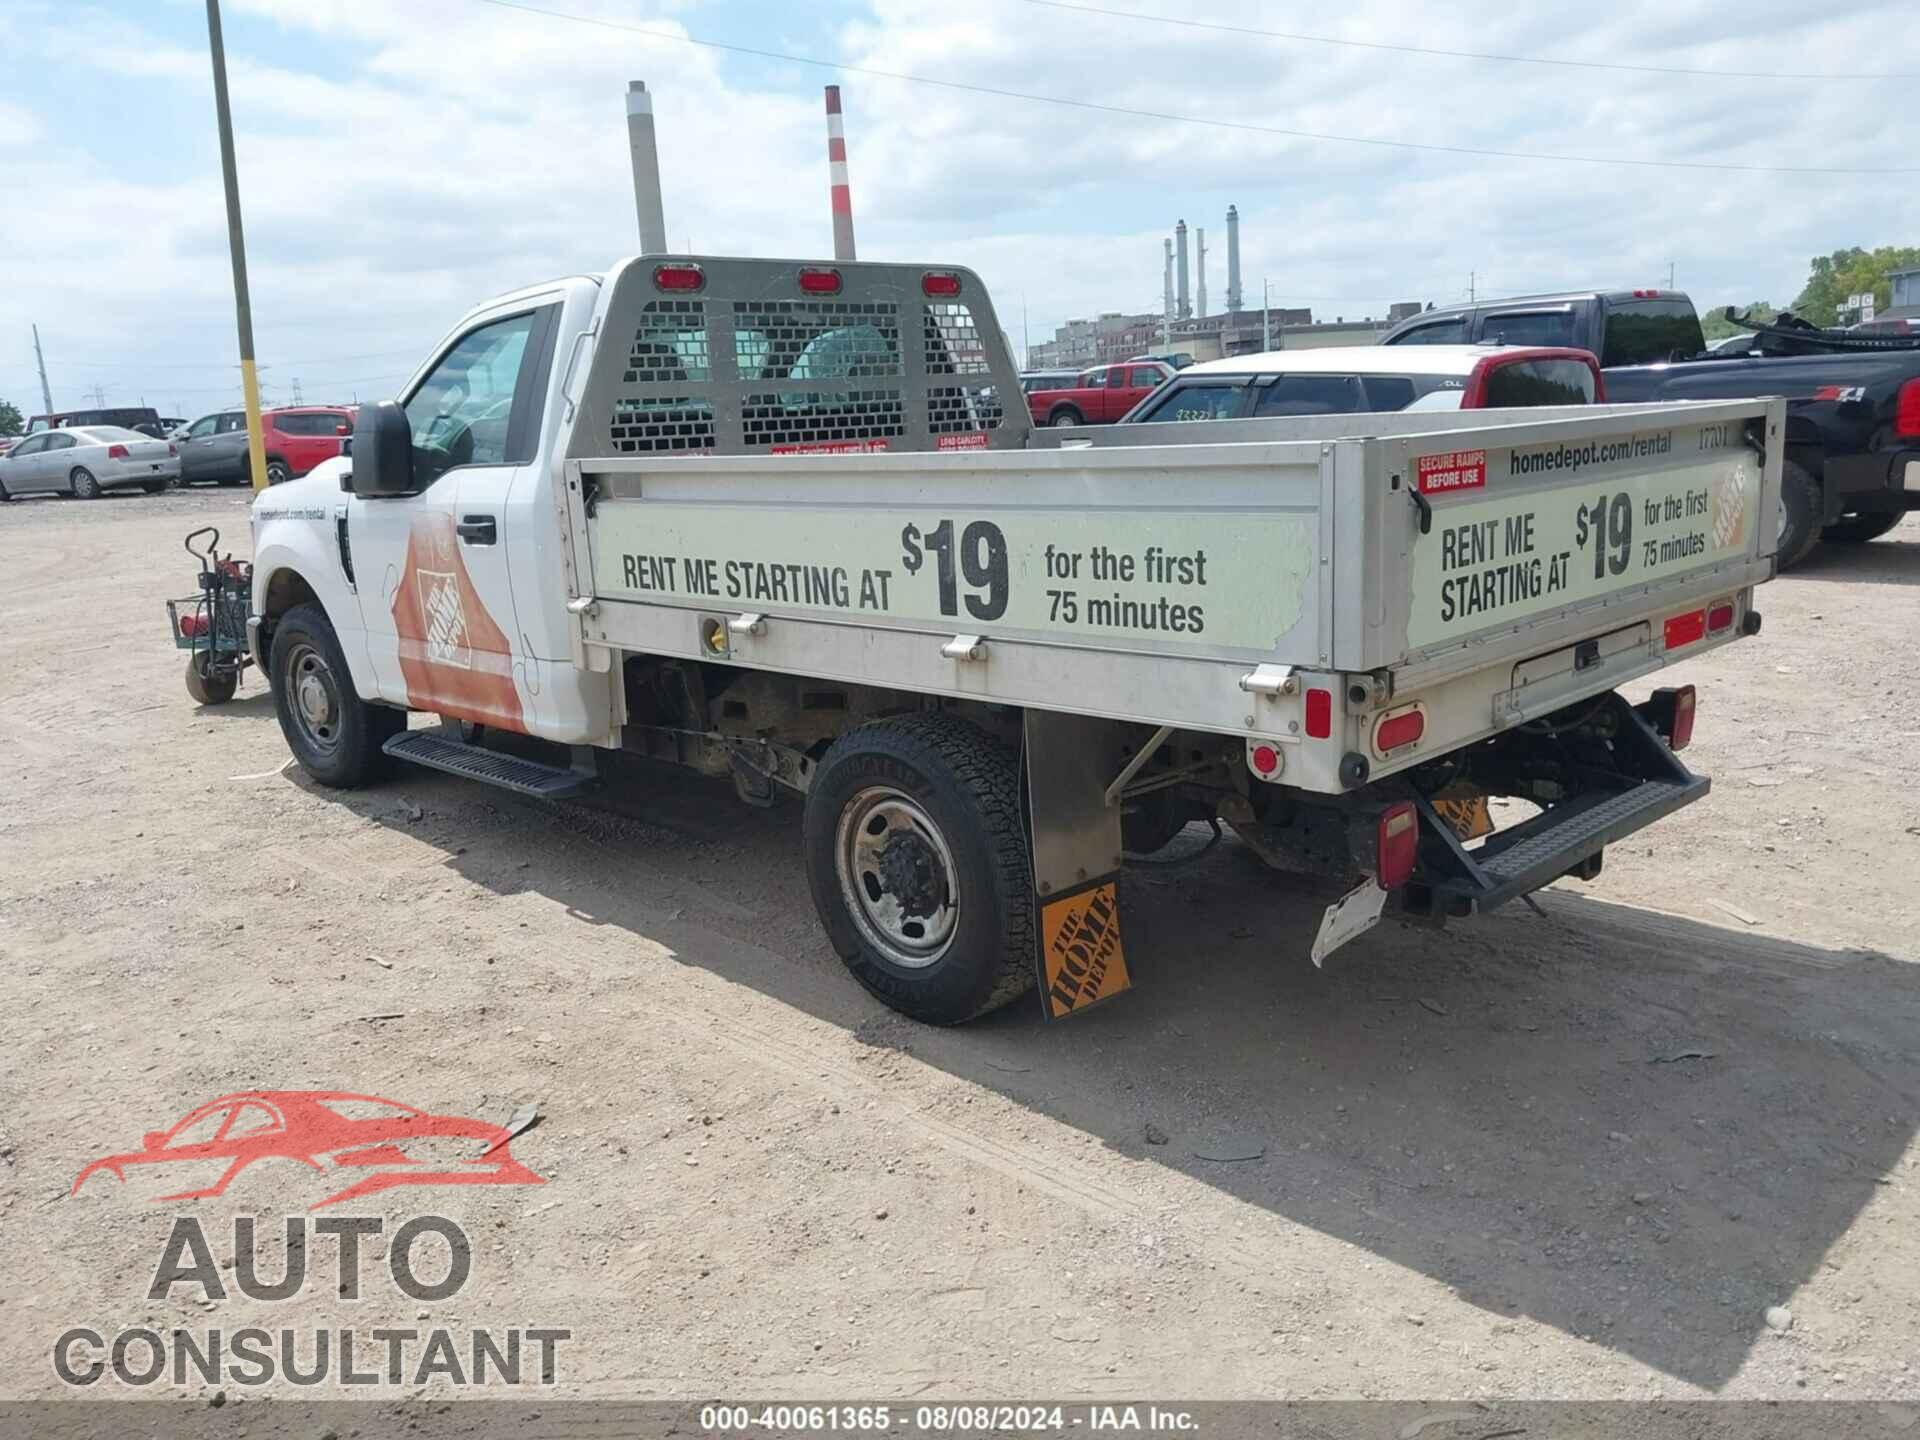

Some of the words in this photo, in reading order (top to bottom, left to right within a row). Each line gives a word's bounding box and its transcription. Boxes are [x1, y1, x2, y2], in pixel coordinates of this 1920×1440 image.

[1420, 455, 1455, 472] SECURE
[1456, 451, 1485, 469] RAMPS
[1511, 432, 1671, 475] homedepot.com/rental
[1426, 471, 1460, 489] BEFORE
[1462, 468, 1479, 484] USE
[1644, 498, 1662, 526] for
[1664, 494, 1682, 522] the
[1686, 488, 1708, 517] first
[1441, 558, 1541, 622] STARTING
[1547, 552, 1570, 593] AT
[1576, 492, 1632, 579] $19
[1442, 520, 1498, 571] RENT
[1505, 513, 1535, 556] ME
[1643, 540, 1657, 568] 75
[1660, 531, 1705, 563] minutes
[623, 554, 676, 592] RENT
[684, 558, 719, 595] ME
[725, 560, 850, 607] STARTING
[859, 569, 892, 610] AT
[902, 519, 1009, 621] $19
[1045, 544, 1082, 579] for
[1090, 546, 1135, 582] the
[1144, 547, 1207, 585] first
[1046, 590, 1078, 624] 75
[1087, 593, 1205, 634] minutes
[1050, 888, 1116, 1010] HOME
[1052, 908, 1081, 955] THE
[1082, 921, 1120, 1000] DEPOT
